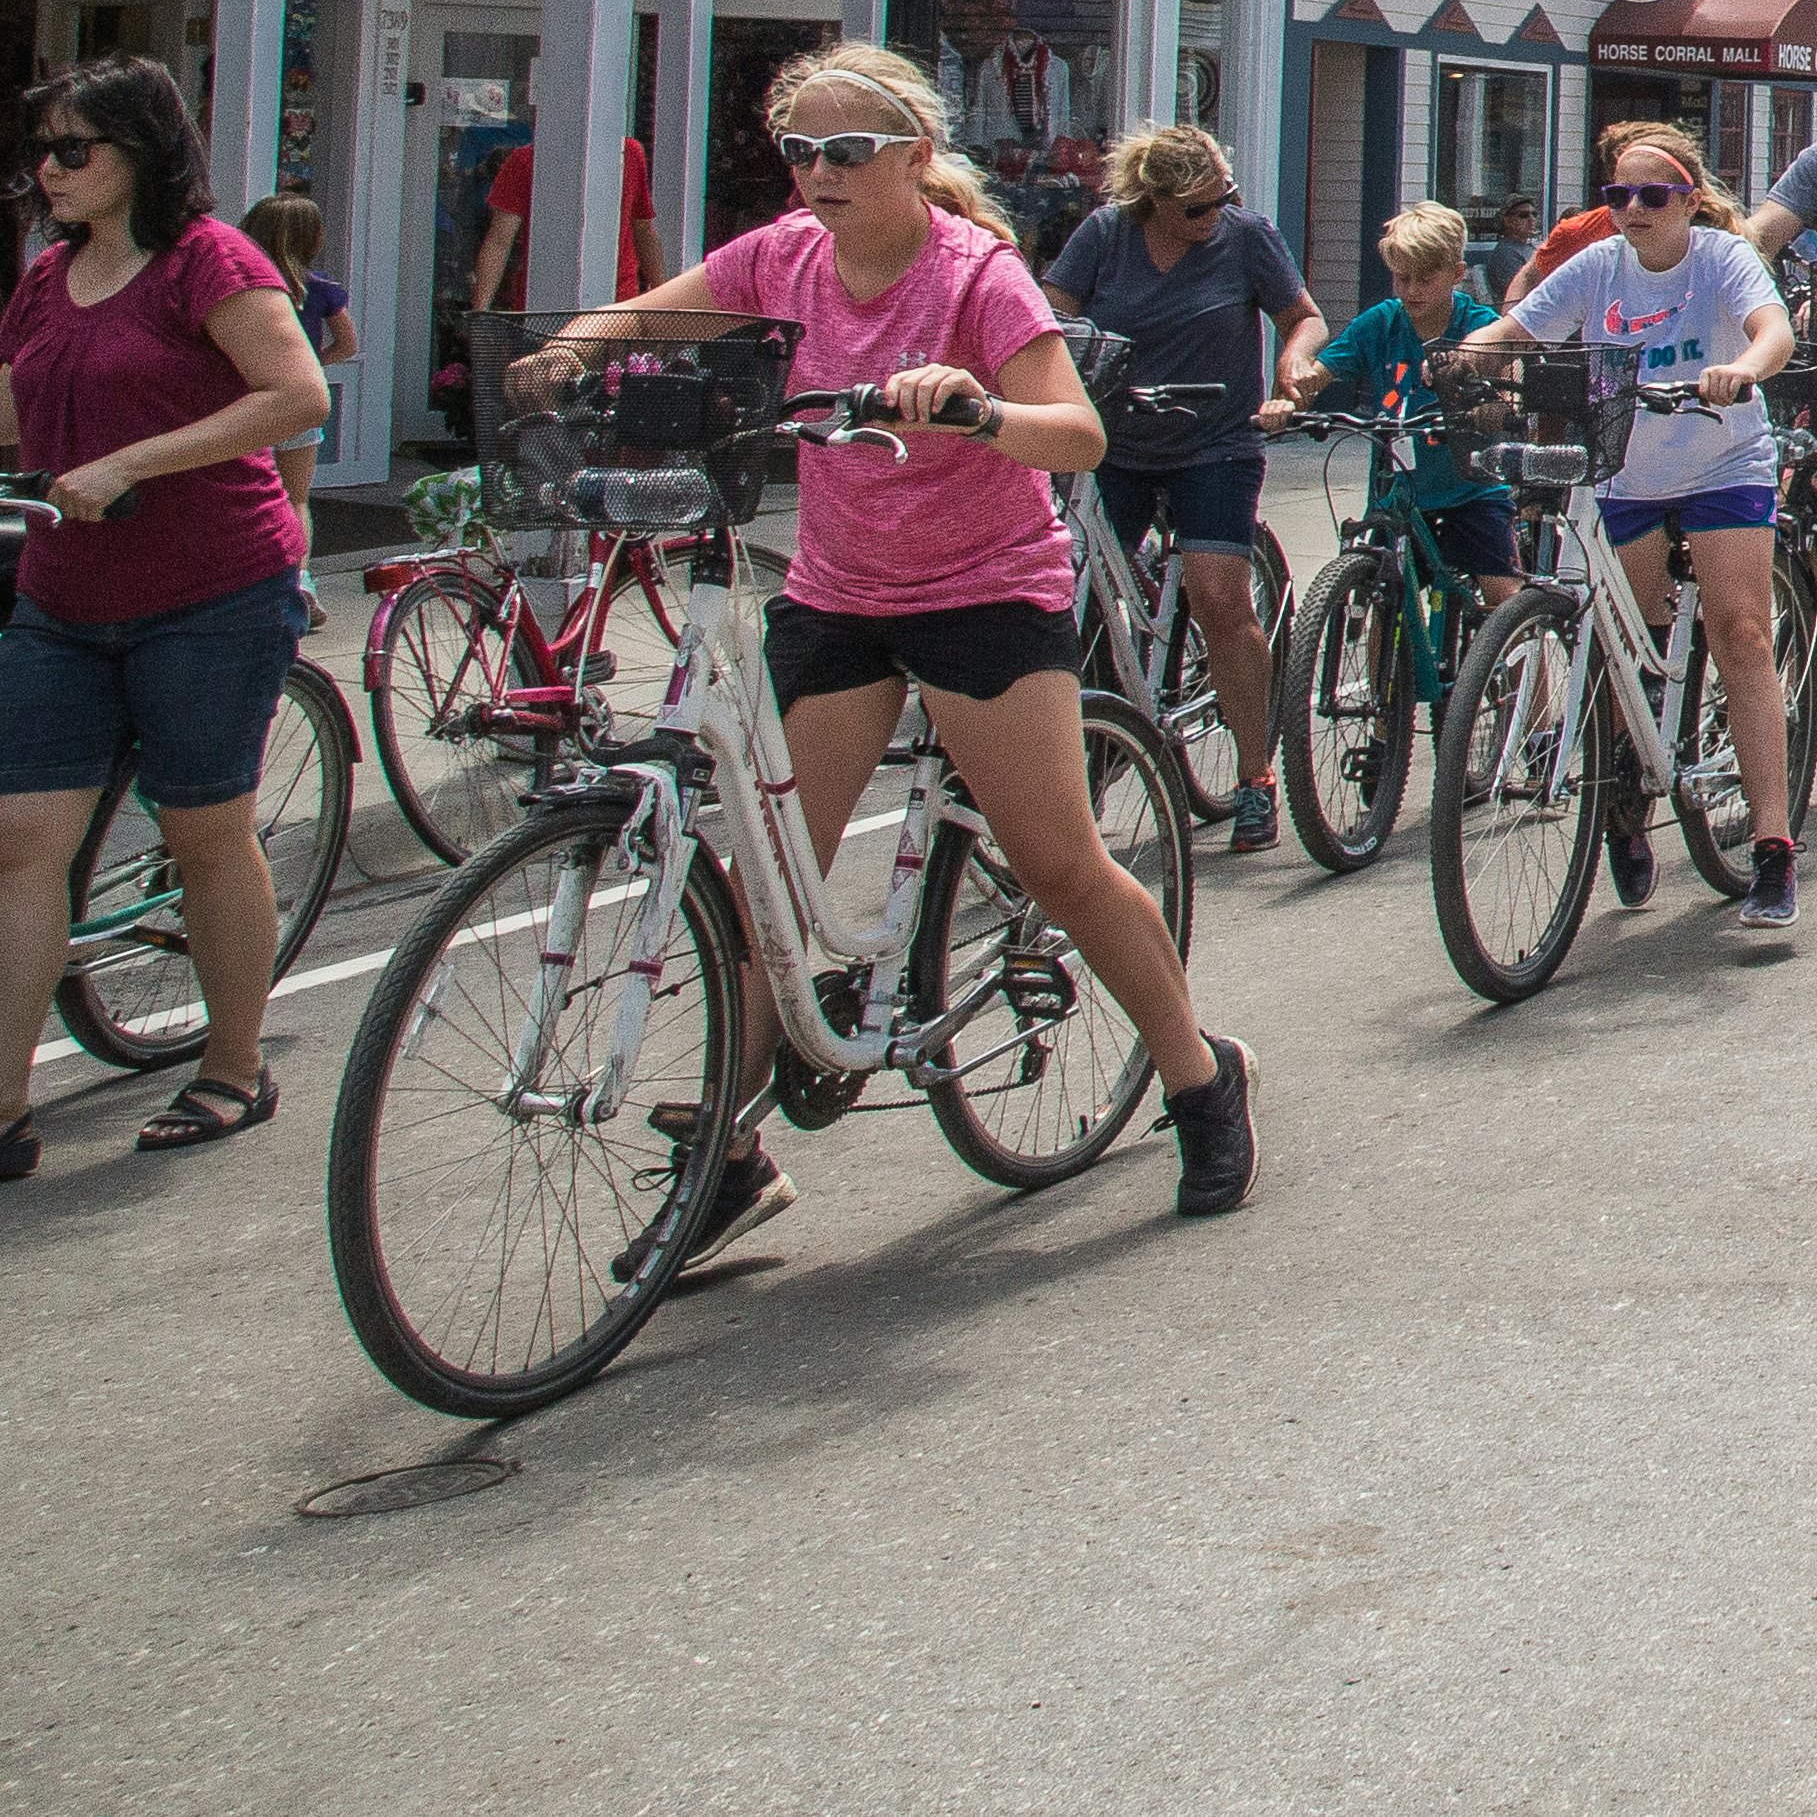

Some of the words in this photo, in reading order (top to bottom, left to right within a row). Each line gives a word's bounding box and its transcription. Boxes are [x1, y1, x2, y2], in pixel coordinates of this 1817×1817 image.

[1598, 44, 1648, 60] HORSE
[1655, 45, 1716, 63] CORRAL
[1722, 47, 1762, 64] MALL
[1778, 44, 1812, 72] HORSE
